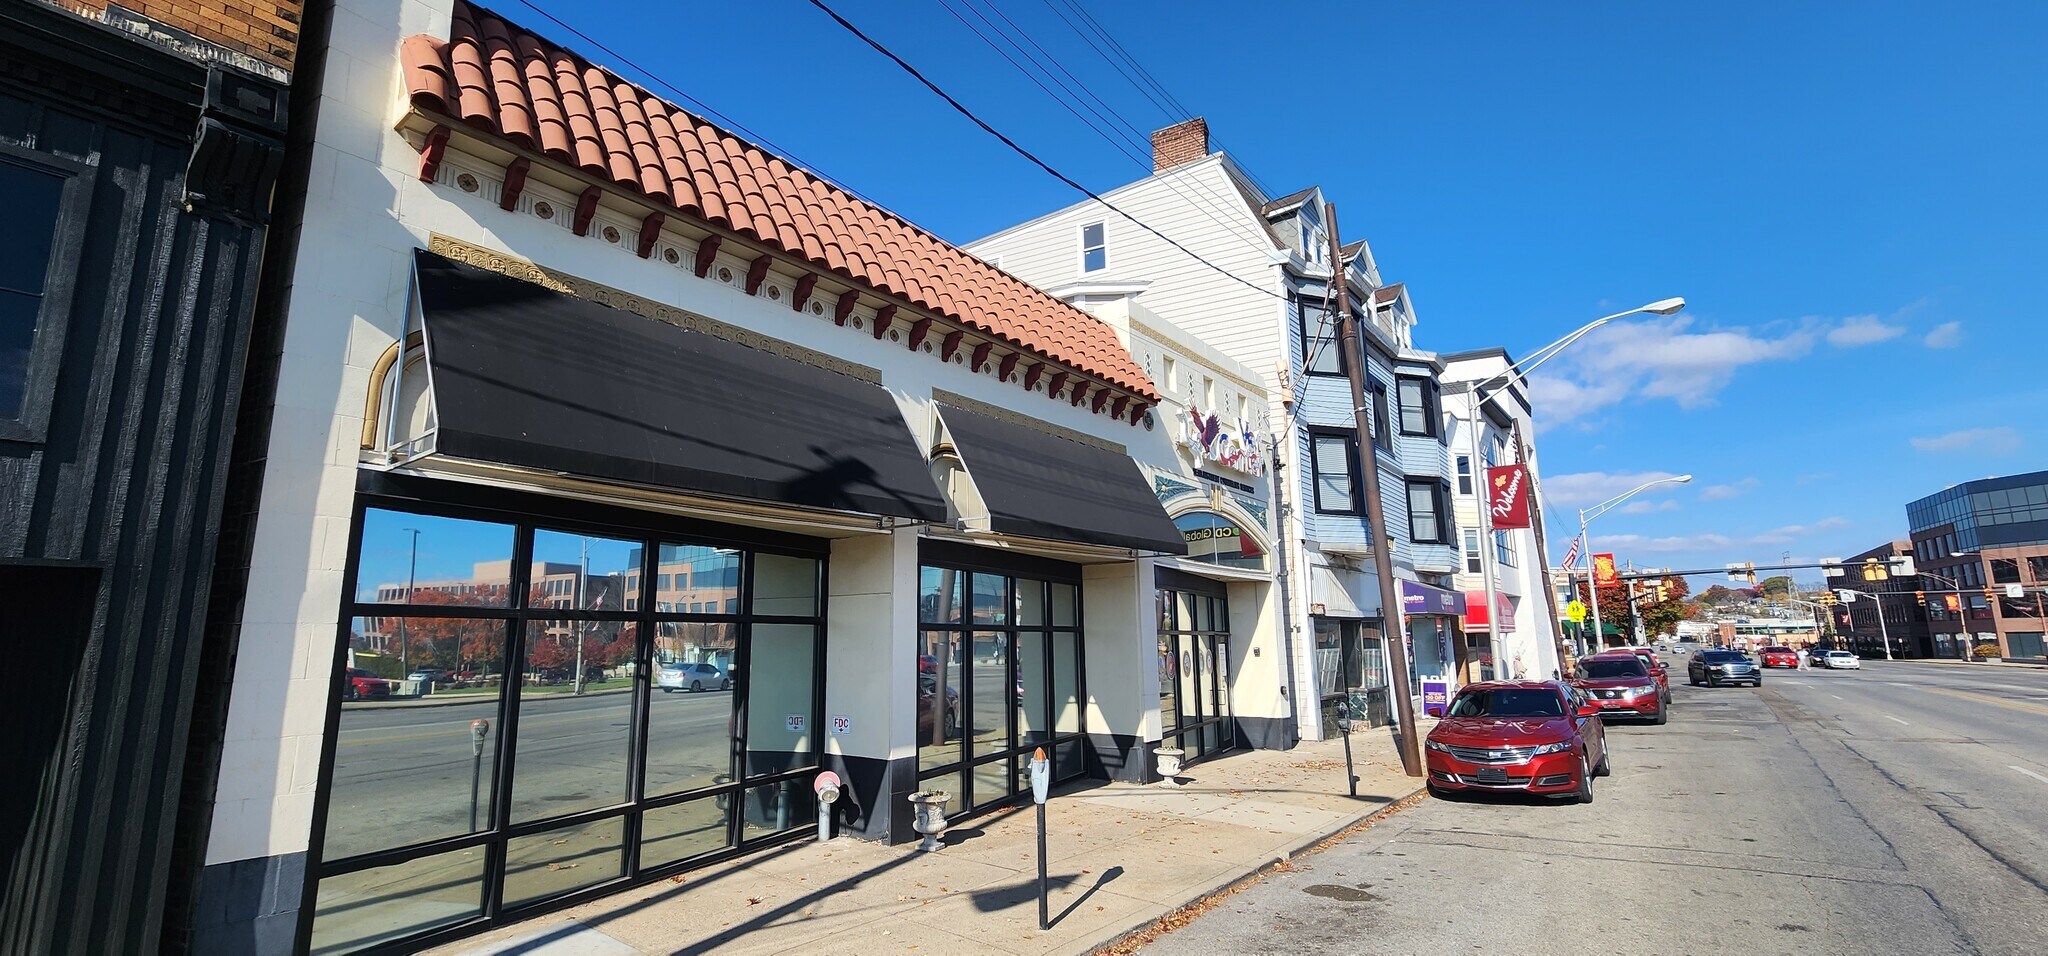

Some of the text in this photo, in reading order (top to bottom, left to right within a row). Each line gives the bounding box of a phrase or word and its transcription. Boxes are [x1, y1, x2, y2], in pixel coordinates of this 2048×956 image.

[1493, 468, 1523, 518] Welcome
[1404, 594, 1425, 602] metro
[834, 718, 849, 728] FDC
